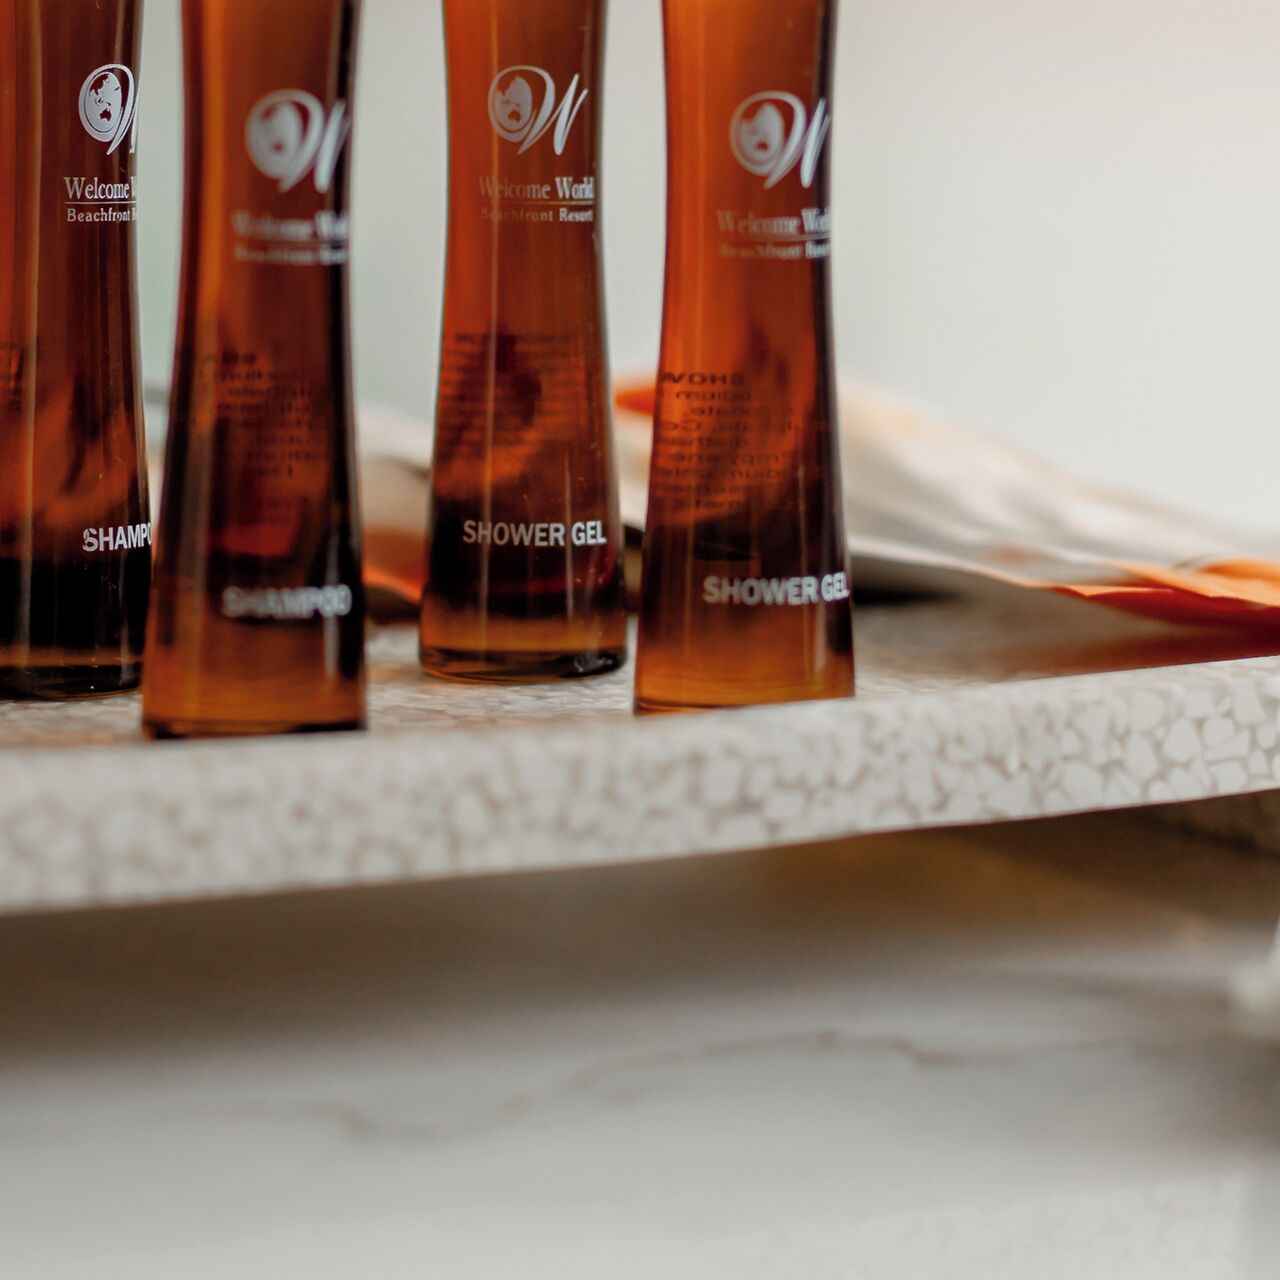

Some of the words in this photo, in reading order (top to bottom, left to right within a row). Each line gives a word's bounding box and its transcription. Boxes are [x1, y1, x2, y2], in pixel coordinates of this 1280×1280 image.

[63, 176, 130, 200] Welcome
[479, 176, 551, 199] Welcome
[67, 207, 131, 222] Beachfront
[463, 520, 565, 547] SHOWER
[571, 520, 607, 545] GEL
[222, 584, 352, 619] SHAMPOO
[703, 576, 818, 606] SHOWER
[821, 572, 850, 602] GEL
